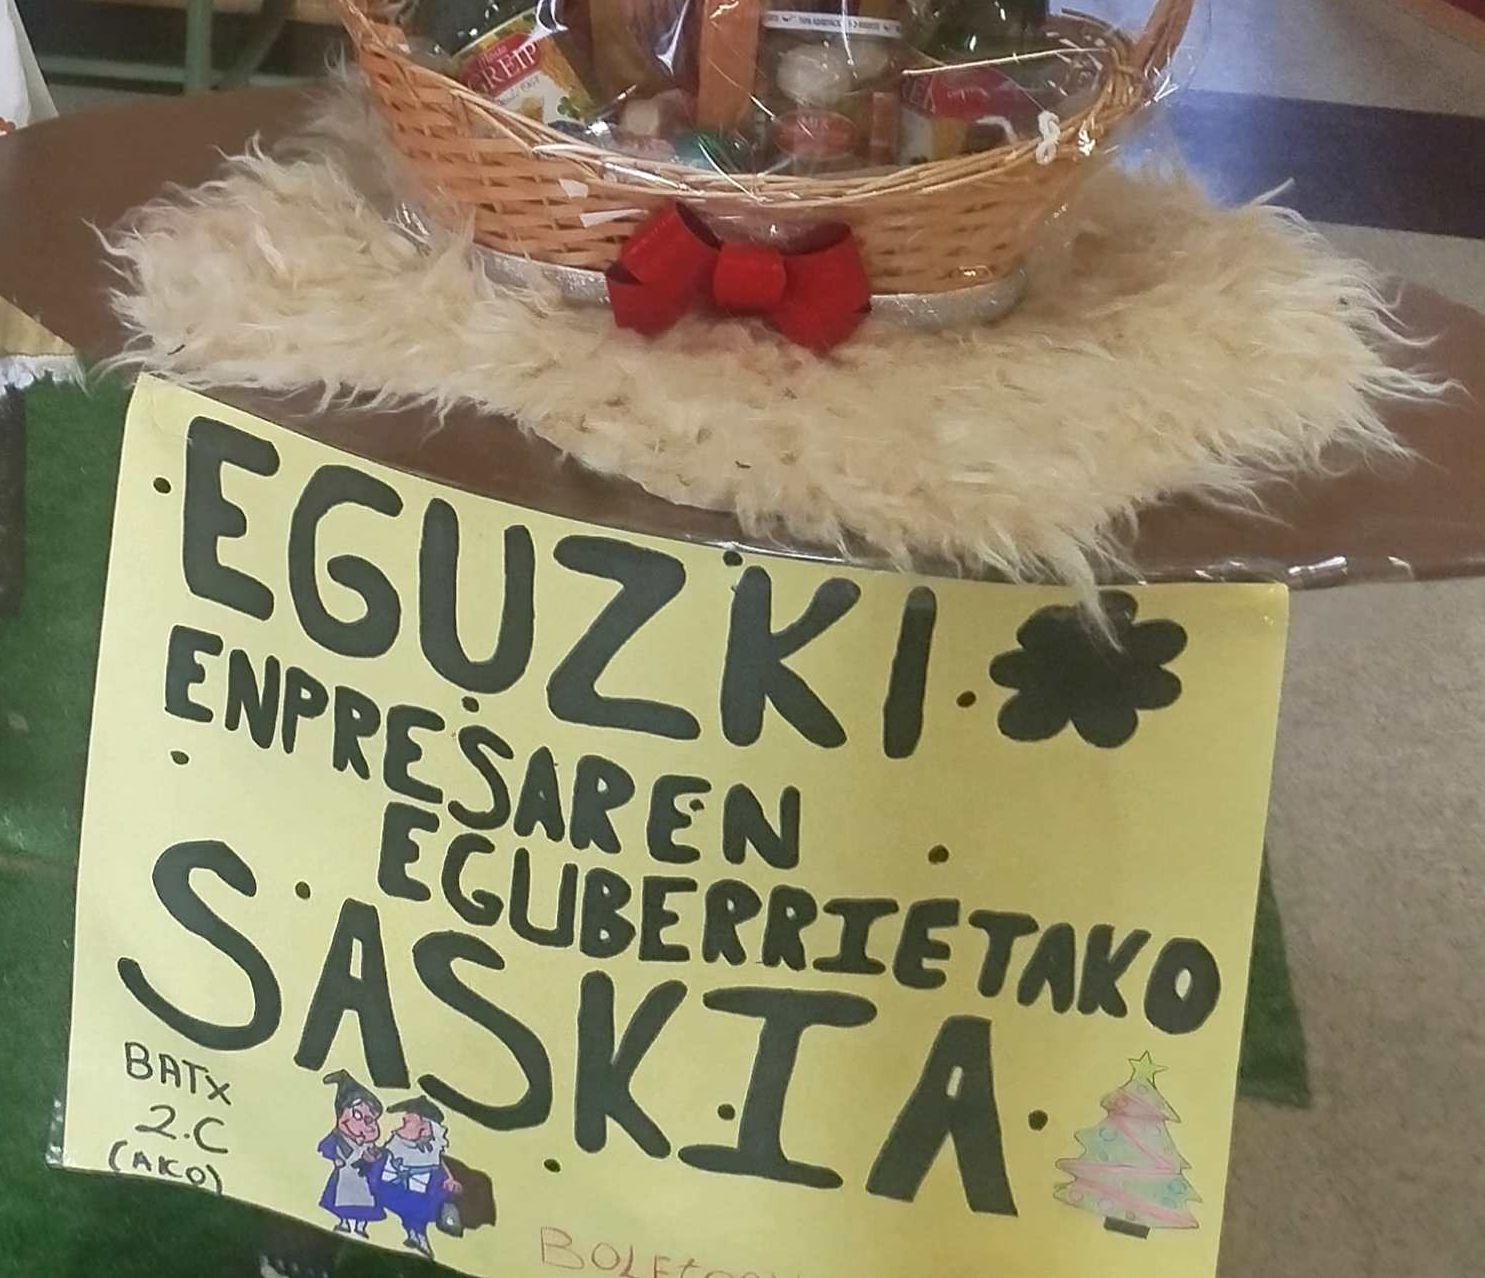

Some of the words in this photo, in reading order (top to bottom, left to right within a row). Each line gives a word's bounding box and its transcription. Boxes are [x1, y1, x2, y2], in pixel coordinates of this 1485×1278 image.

[468, 41, 537, 93] GREIP
[183, 416, 937, 759] EGUZKI
[165, 625, 801, 870] ENPRESAREN
[117, 840, 1019, 1218] SASKIA
[378, 801, 1221, 1034] EGUBERRIETAKO
[108, 1140, 223, 1196] (AKO)
